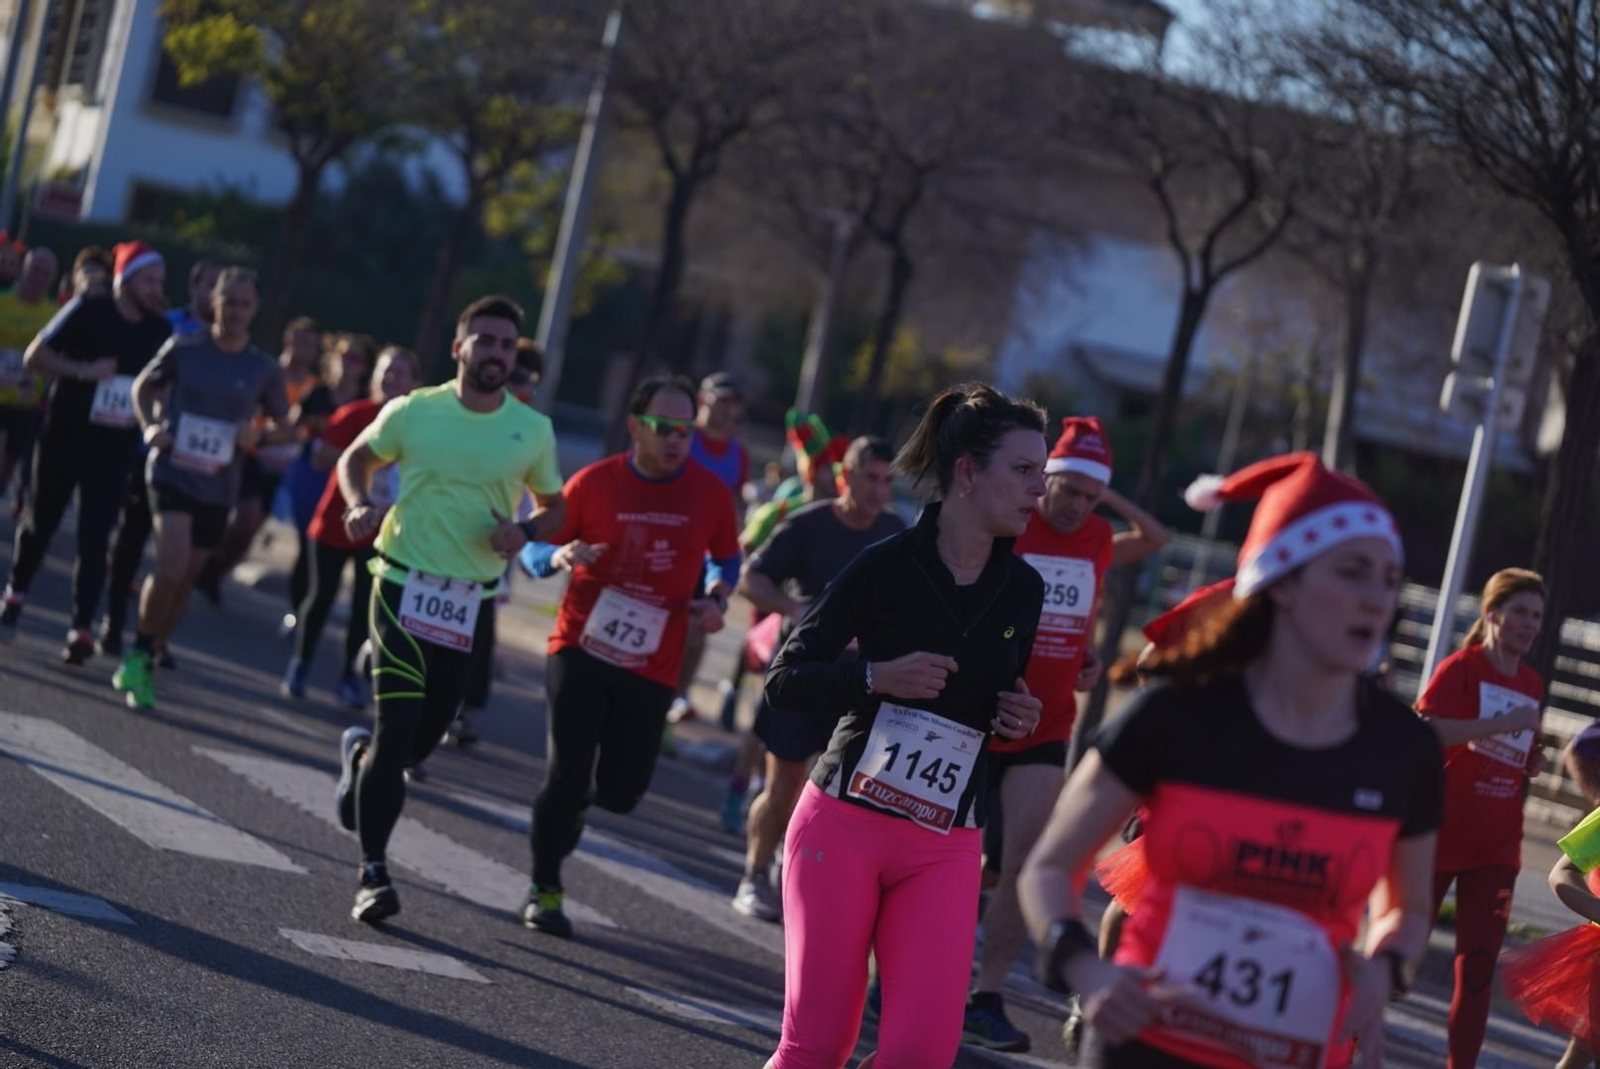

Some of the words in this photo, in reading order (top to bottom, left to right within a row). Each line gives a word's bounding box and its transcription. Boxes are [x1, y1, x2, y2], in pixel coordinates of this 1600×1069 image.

[413, 592, 468, 626] 1084
[603, 618, 648, 648] 473
[884, 742, 962, 794] 1145
[859, 777, 937, 820] Cruzcampo
[1192, 952, 1295, 1016] 431
